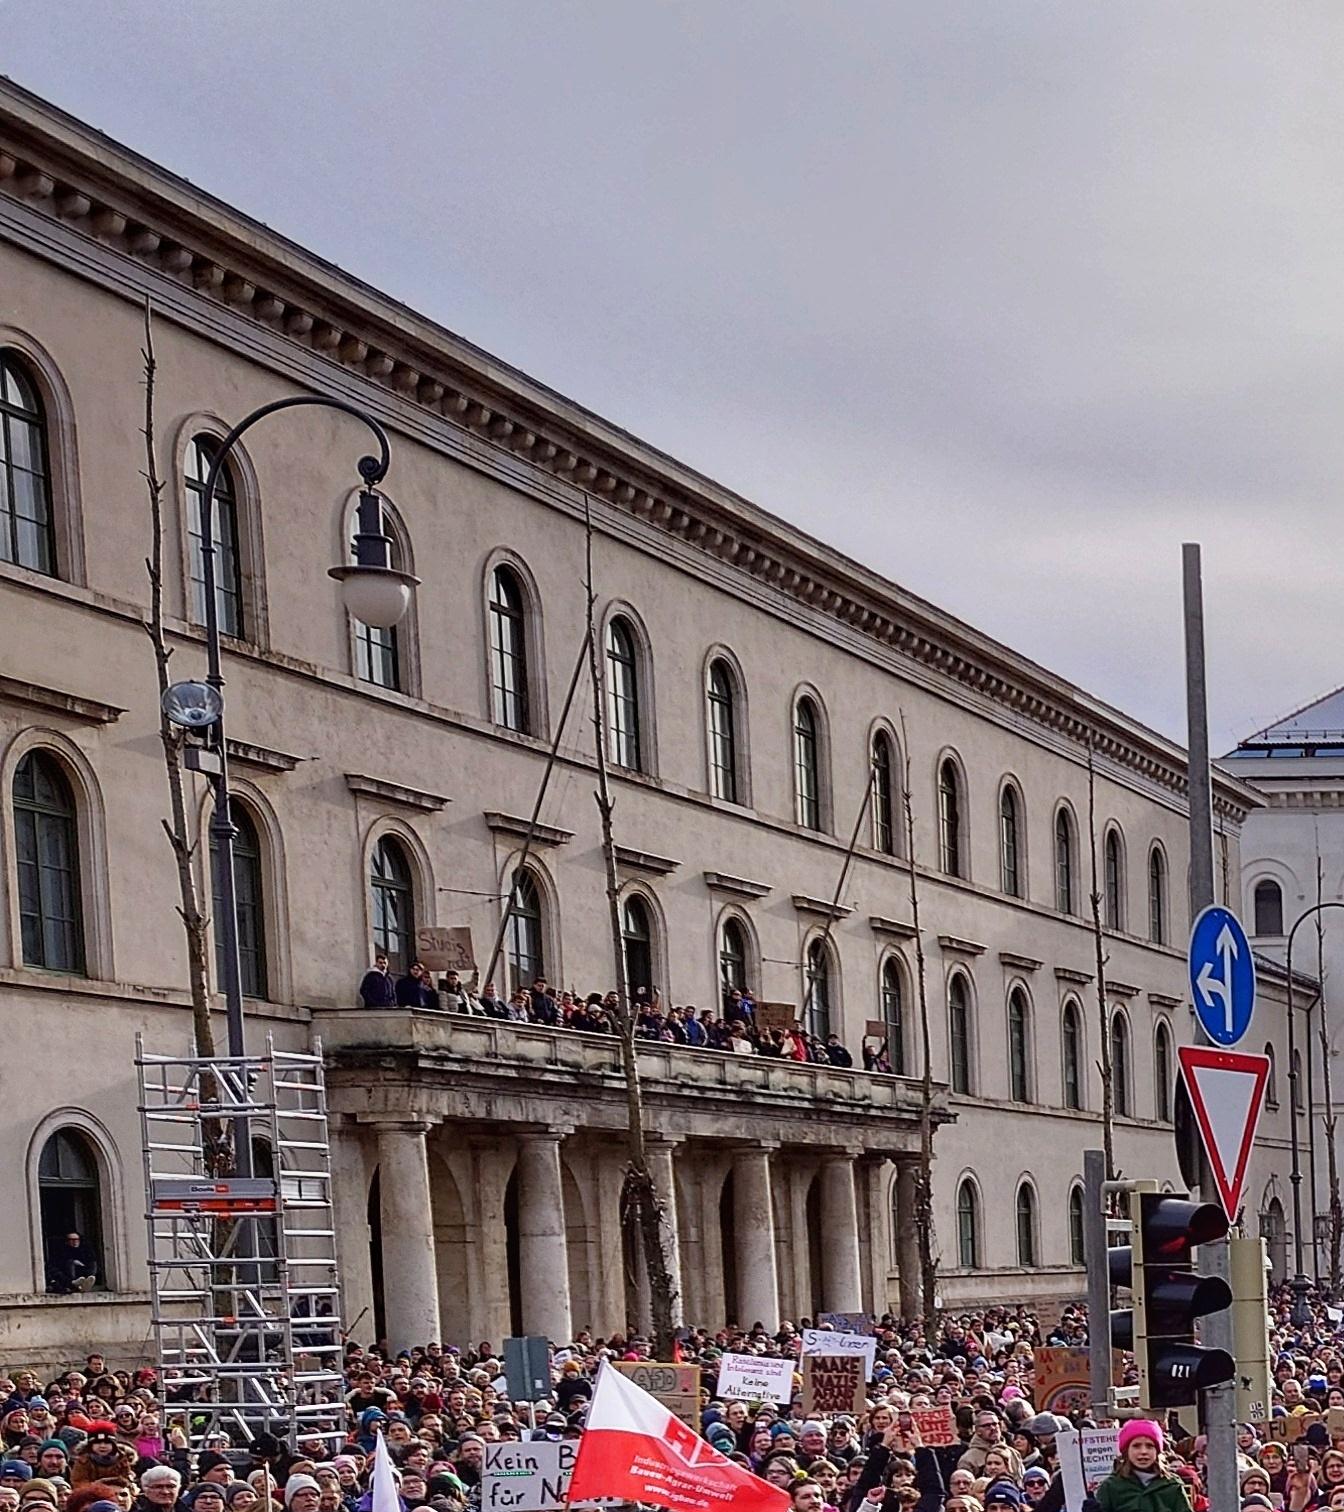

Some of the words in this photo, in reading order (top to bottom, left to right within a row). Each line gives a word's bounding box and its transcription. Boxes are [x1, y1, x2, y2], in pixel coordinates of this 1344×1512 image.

[811, 1357, 860, 1374] MAKE
[812, 1374, 858, 1388] NAZIS
[724, 1385, 781, 1400] Alternative
[813, 1388, 855, 1400] AFRAID
[813, 1399, 854, 1412] AGAIN
[486, 1446, 539, 1470] Kein
[629, 1465, 734, 1501] Bauen-Agrar-Umwelt
[489, 1482, 525, 1507] für
